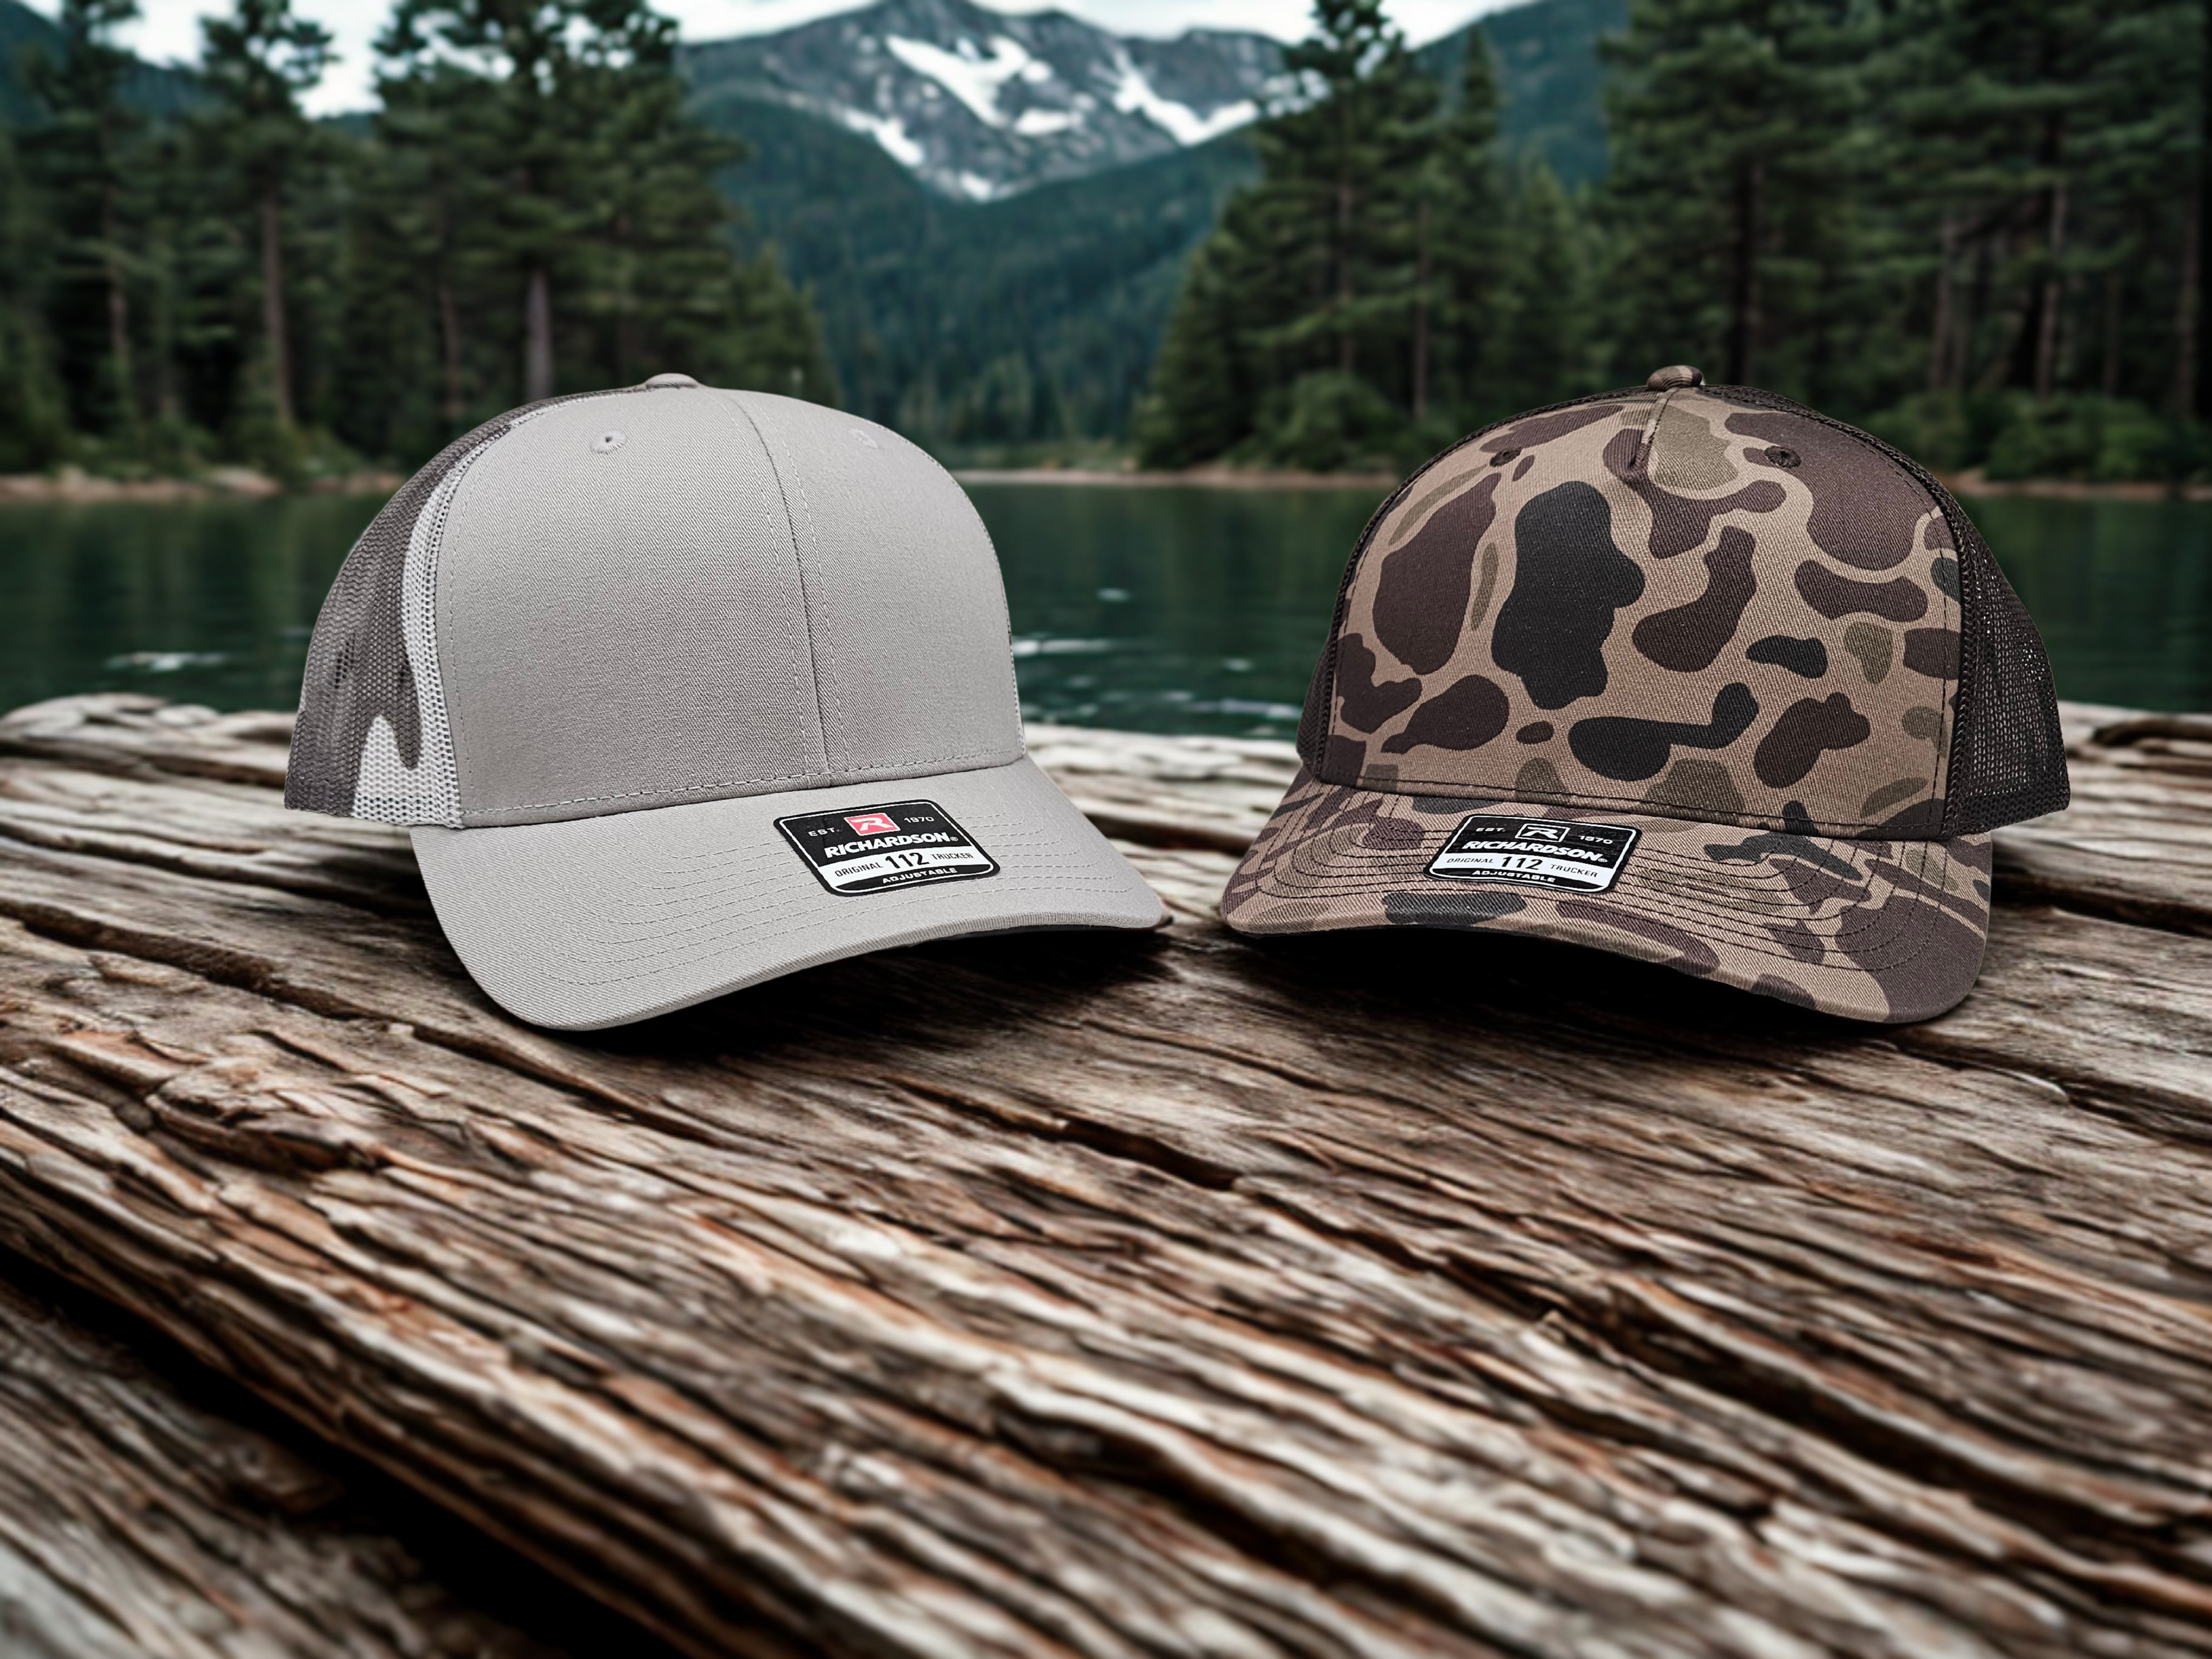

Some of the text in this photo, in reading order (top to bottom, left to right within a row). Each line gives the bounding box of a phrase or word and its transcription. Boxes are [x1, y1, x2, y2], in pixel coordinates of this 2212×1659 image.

[808, 816, 935, 837] EST. 1970
[834, 862, 885, 877] ORIGINAL
[885, 852, 930, 869] 112
[1501, 856, 1543, 871] 112
[1550, 863, 1598, 878] TRUCKER
[882, 867, 958, 884] ADJUSTABLE
[1471, 869, 1556, 883] ADJUSTABLE
